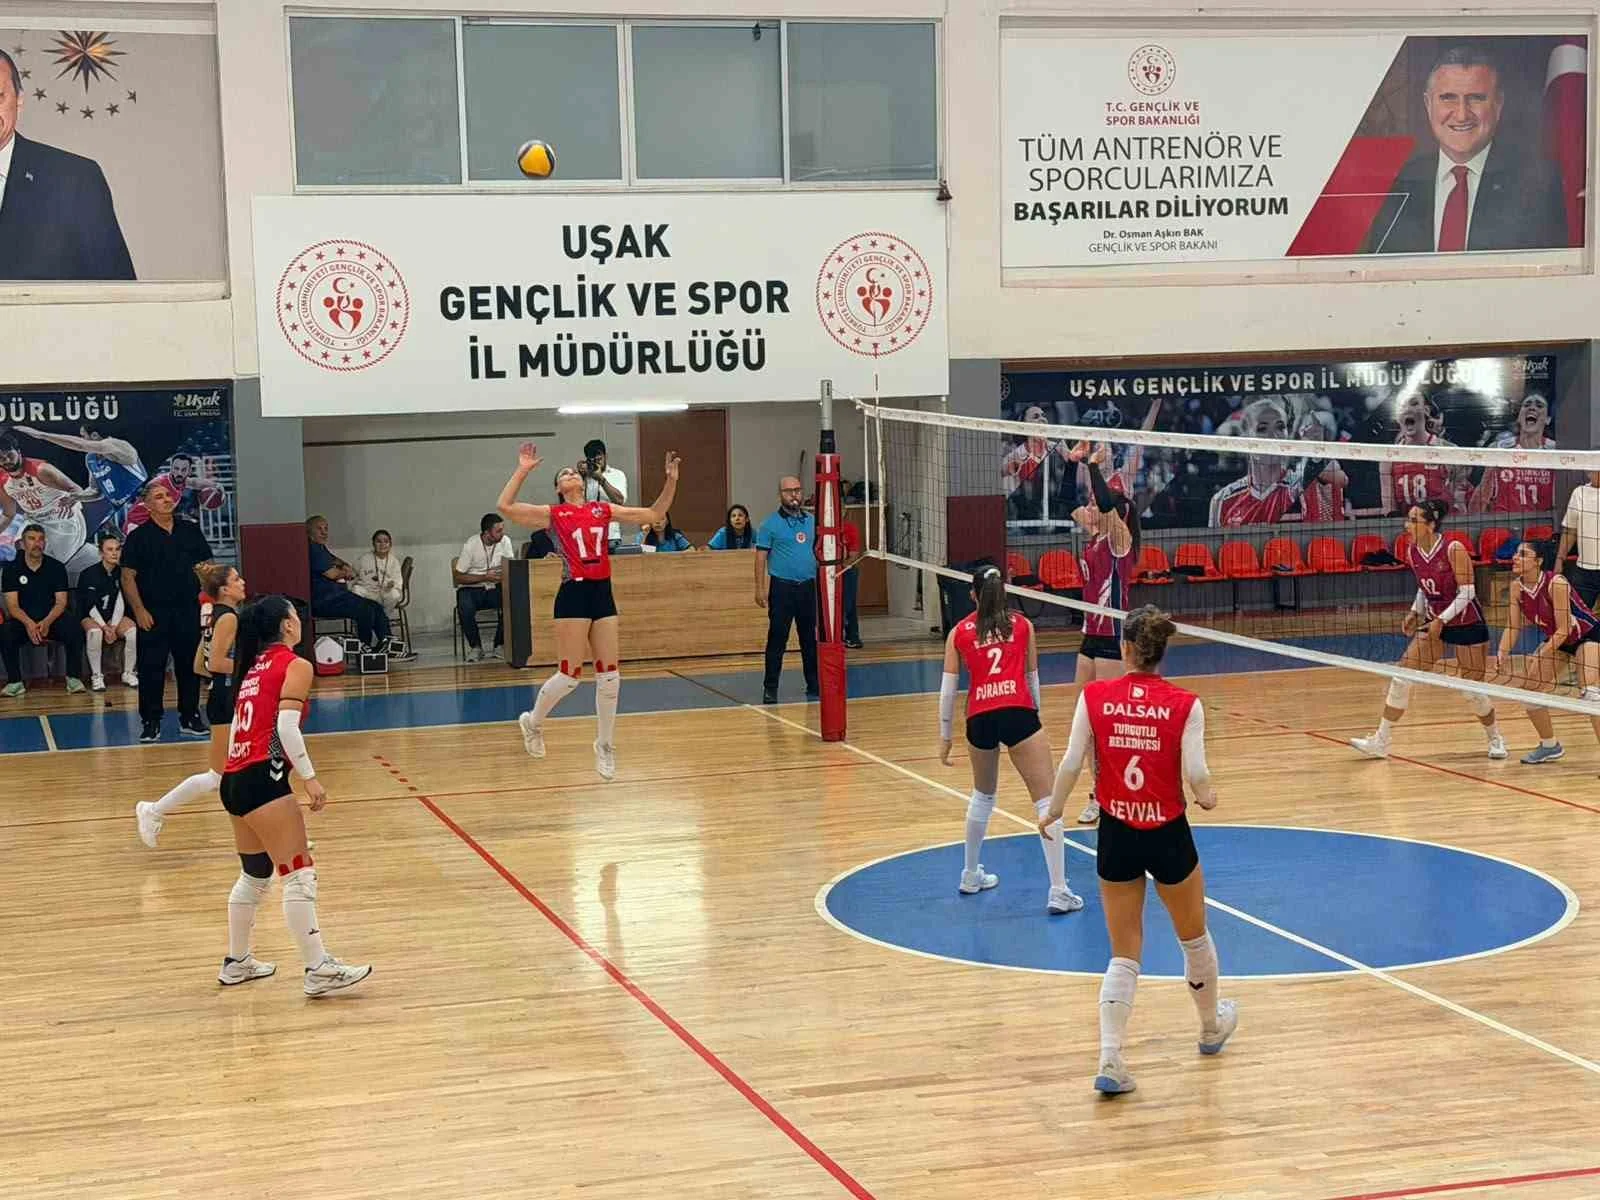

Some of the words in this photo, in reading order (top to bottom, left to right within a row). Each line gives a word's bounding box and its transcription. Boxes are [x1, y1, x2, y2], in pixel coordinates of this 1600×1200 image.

[1106, 102, 1127, 112] T.C.
[1130, 101, 1180, 114] GENÇLİK
[1184, 101, 1199, 112] VE
[1106, 116, 1136, 126] SPOR
[1138, 114, 1200, 126] BAKANLIĞI
[1018, 133, 1084, 162] TÜM
[1093, 131, 1242, 161] ANTRENÖR
[1249, 135, 1282, 158] VE
[1029, 164, 1274, 192] SPORCULARIMIZA
[1014, 199, 1150, 226] BAŞARILAR
[1155, 194, 1289, 218] DİLİYORUM
[562, 223, 671, 265] UŞAK
[1088, 241, 1132, 254] GENÇLİK
[1134, 242, 1147, 251] VE
[1149, 241, 1177, 251] SPOR
[1179, 240, 1218, 250] BAKANI
[1103, 229, 1117, 239] Dr.
[1119, 229, 1151, 239] Osman
[1154, 228, 1181, 241] Aşkın
[1184, 228, 1204, 237] BAK
[439, 273, 619, 326] GENÇLİK
[626, 281, 677, 317] VE
[688, 279, 791, 316] SPOR
[469, 335, 506, 380] İL
[518, 328, 766, 379] MÜDÜRLÜĞÜ
[1070, 379, 1127, 399] UŞAK
[1133, 371, 1225, 397] GENÇLİK
[1227, 374, 1256, 392] VE
[1261, 372, 1315, 392] SPOR
[1321, 367, 1340, 389] İL
[185, 390, 221, 409] Uşak
[571, 526, 604, 559] 17
[987, 647, 1003, 676] 2
[1103, 702, 1170, 720] DALSAN
[1123, 755, 1145, 791] 6
